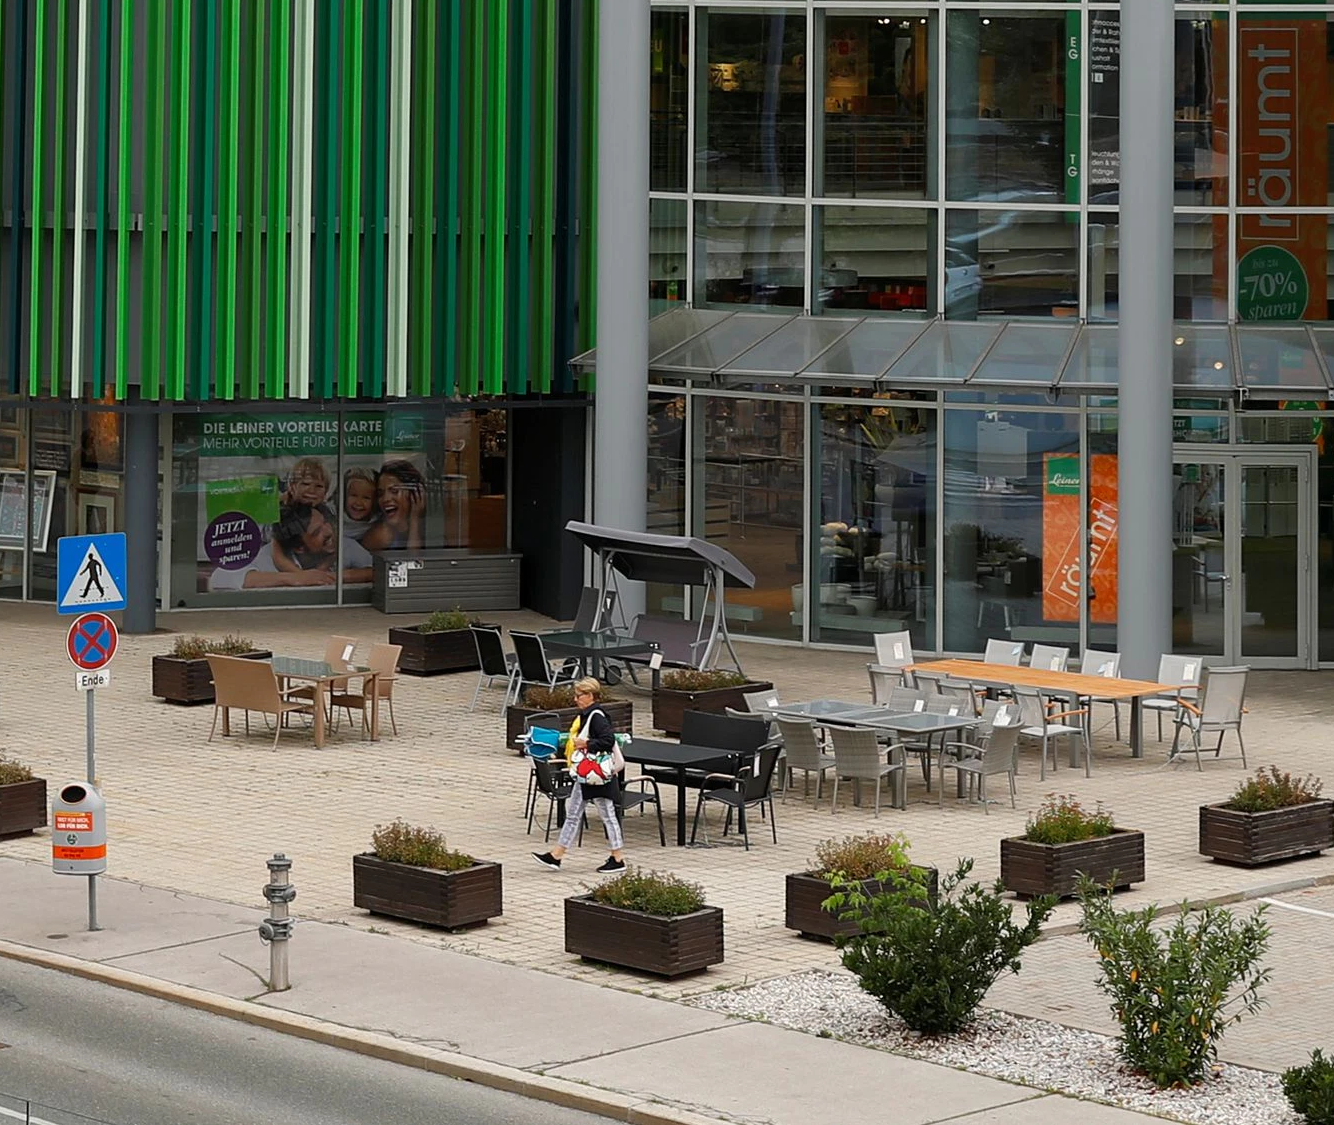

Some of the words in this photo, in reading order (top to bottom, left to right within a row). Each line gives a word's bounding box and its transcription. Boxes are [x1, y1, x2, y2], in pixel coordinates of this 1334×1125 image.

[1248, 44, 1291, 227] räumt
[1240, 271, 1297, 301] -70%
[1248, 302, 1296, 321] sparen
[203, 422, 226, 435] DIE
[229, 421, 274, 434] LEINER
[203, 436, 240, 449] MEHR
[242, 435, 299, 449] VORTEILE
[302, 433, 326, 448] FÜR
[329, 434, 382, 448] DAHEIM!
[212, 519, 248, 538] JETZT
[211, 533, 253, 548] anmelden
[224, 543, 243, 554] und
[218, 551, 251, 565] sparen!
[82, 674, 104, 686] Ende
